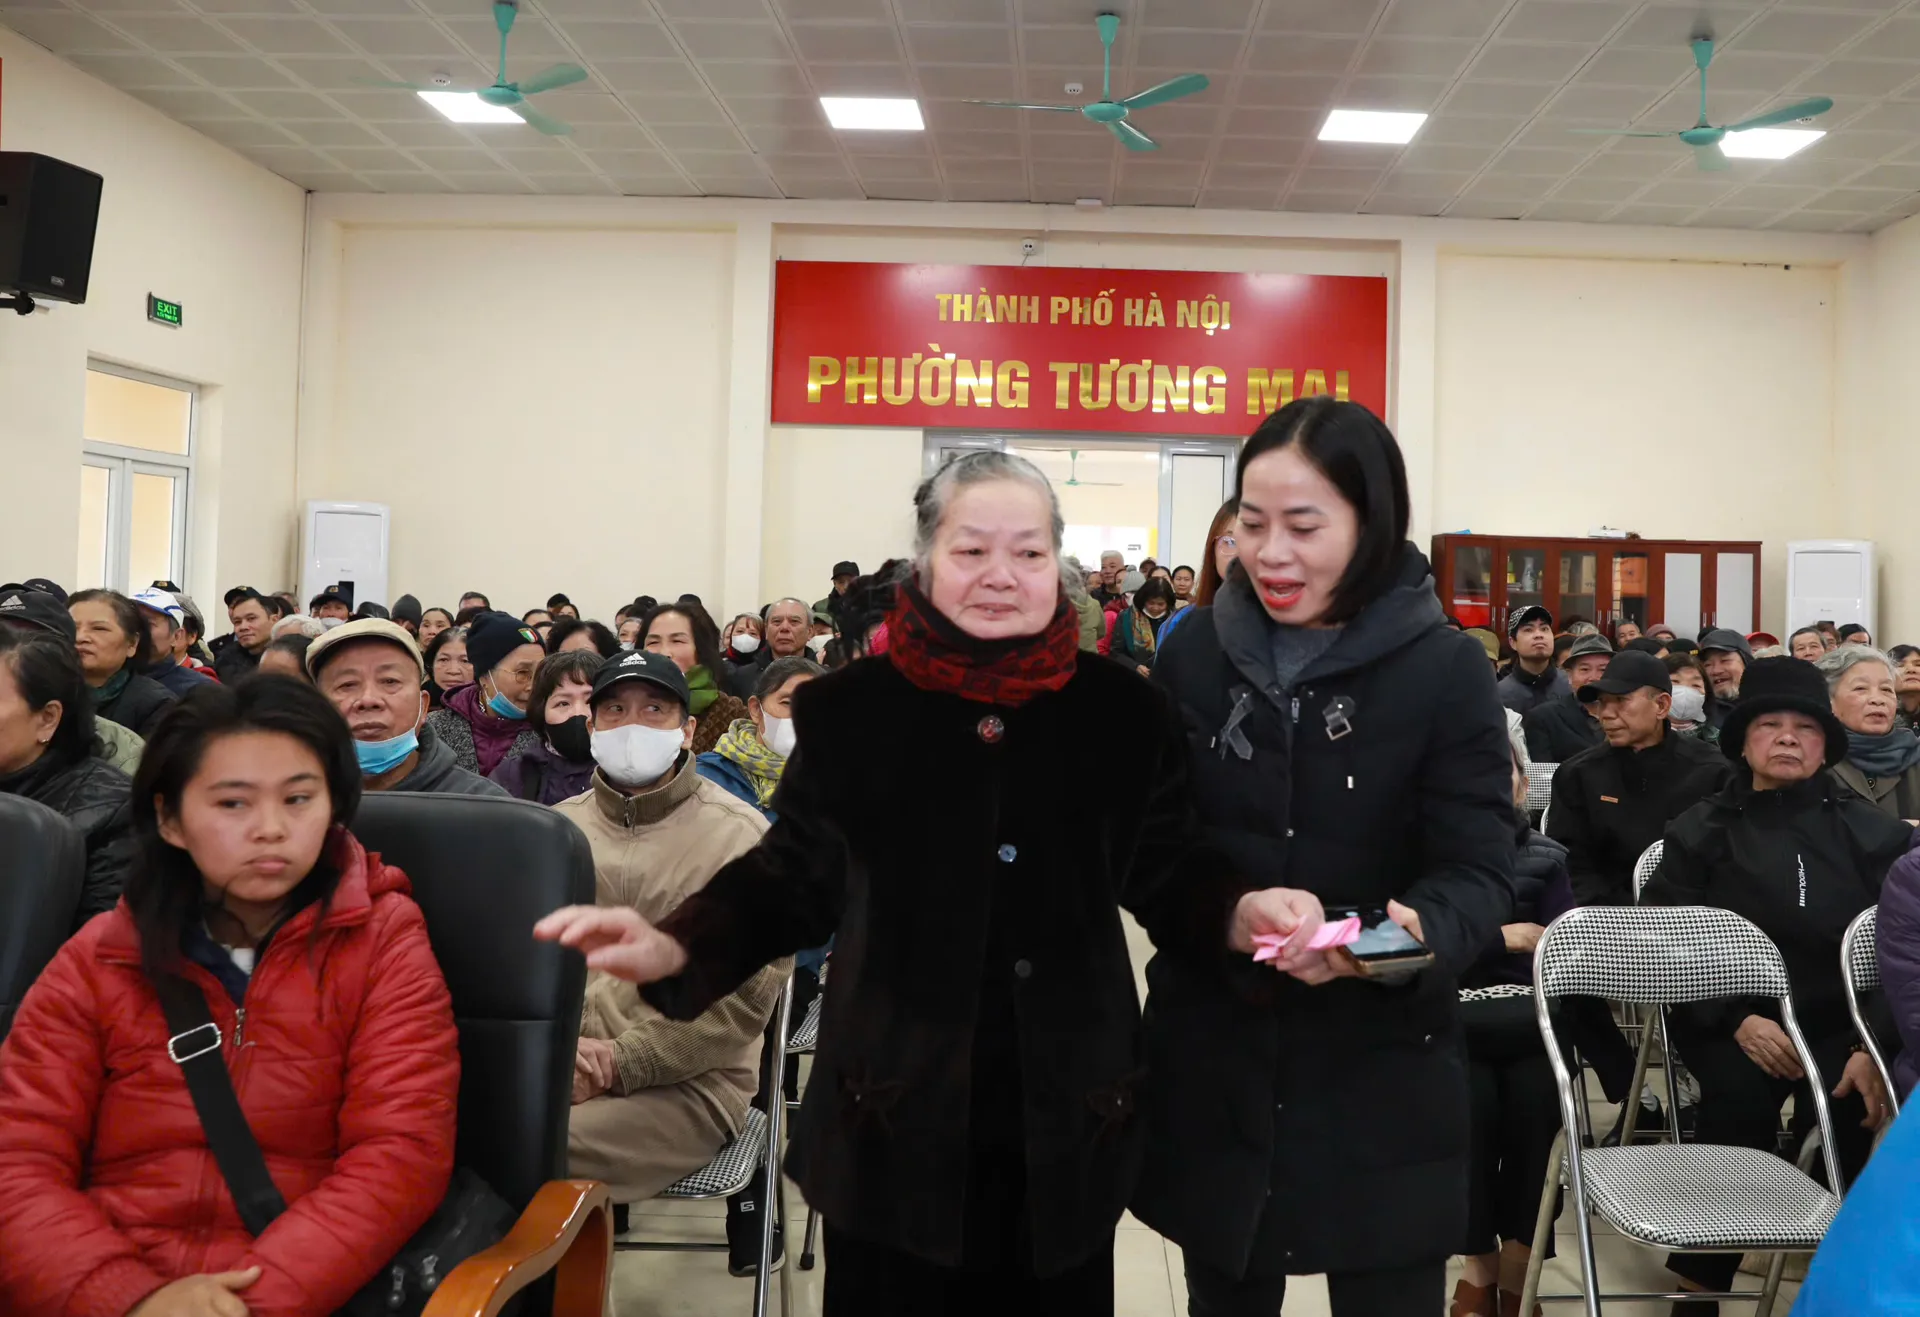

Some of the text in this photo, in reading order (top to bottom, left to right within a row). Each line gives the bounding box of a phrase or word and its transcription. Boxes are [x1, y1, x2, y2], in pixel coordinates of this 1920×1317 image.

[157, 301, 178, 316] EXIT
[935, 287, 1231, 336] THÀNH PHỐ HÀ NỘI
[807, 343, 1030, 408] PHƯỜNG
[1049, 358, 1227, 414] TƯƠNG
[619, 660, 647, 668] adidas
